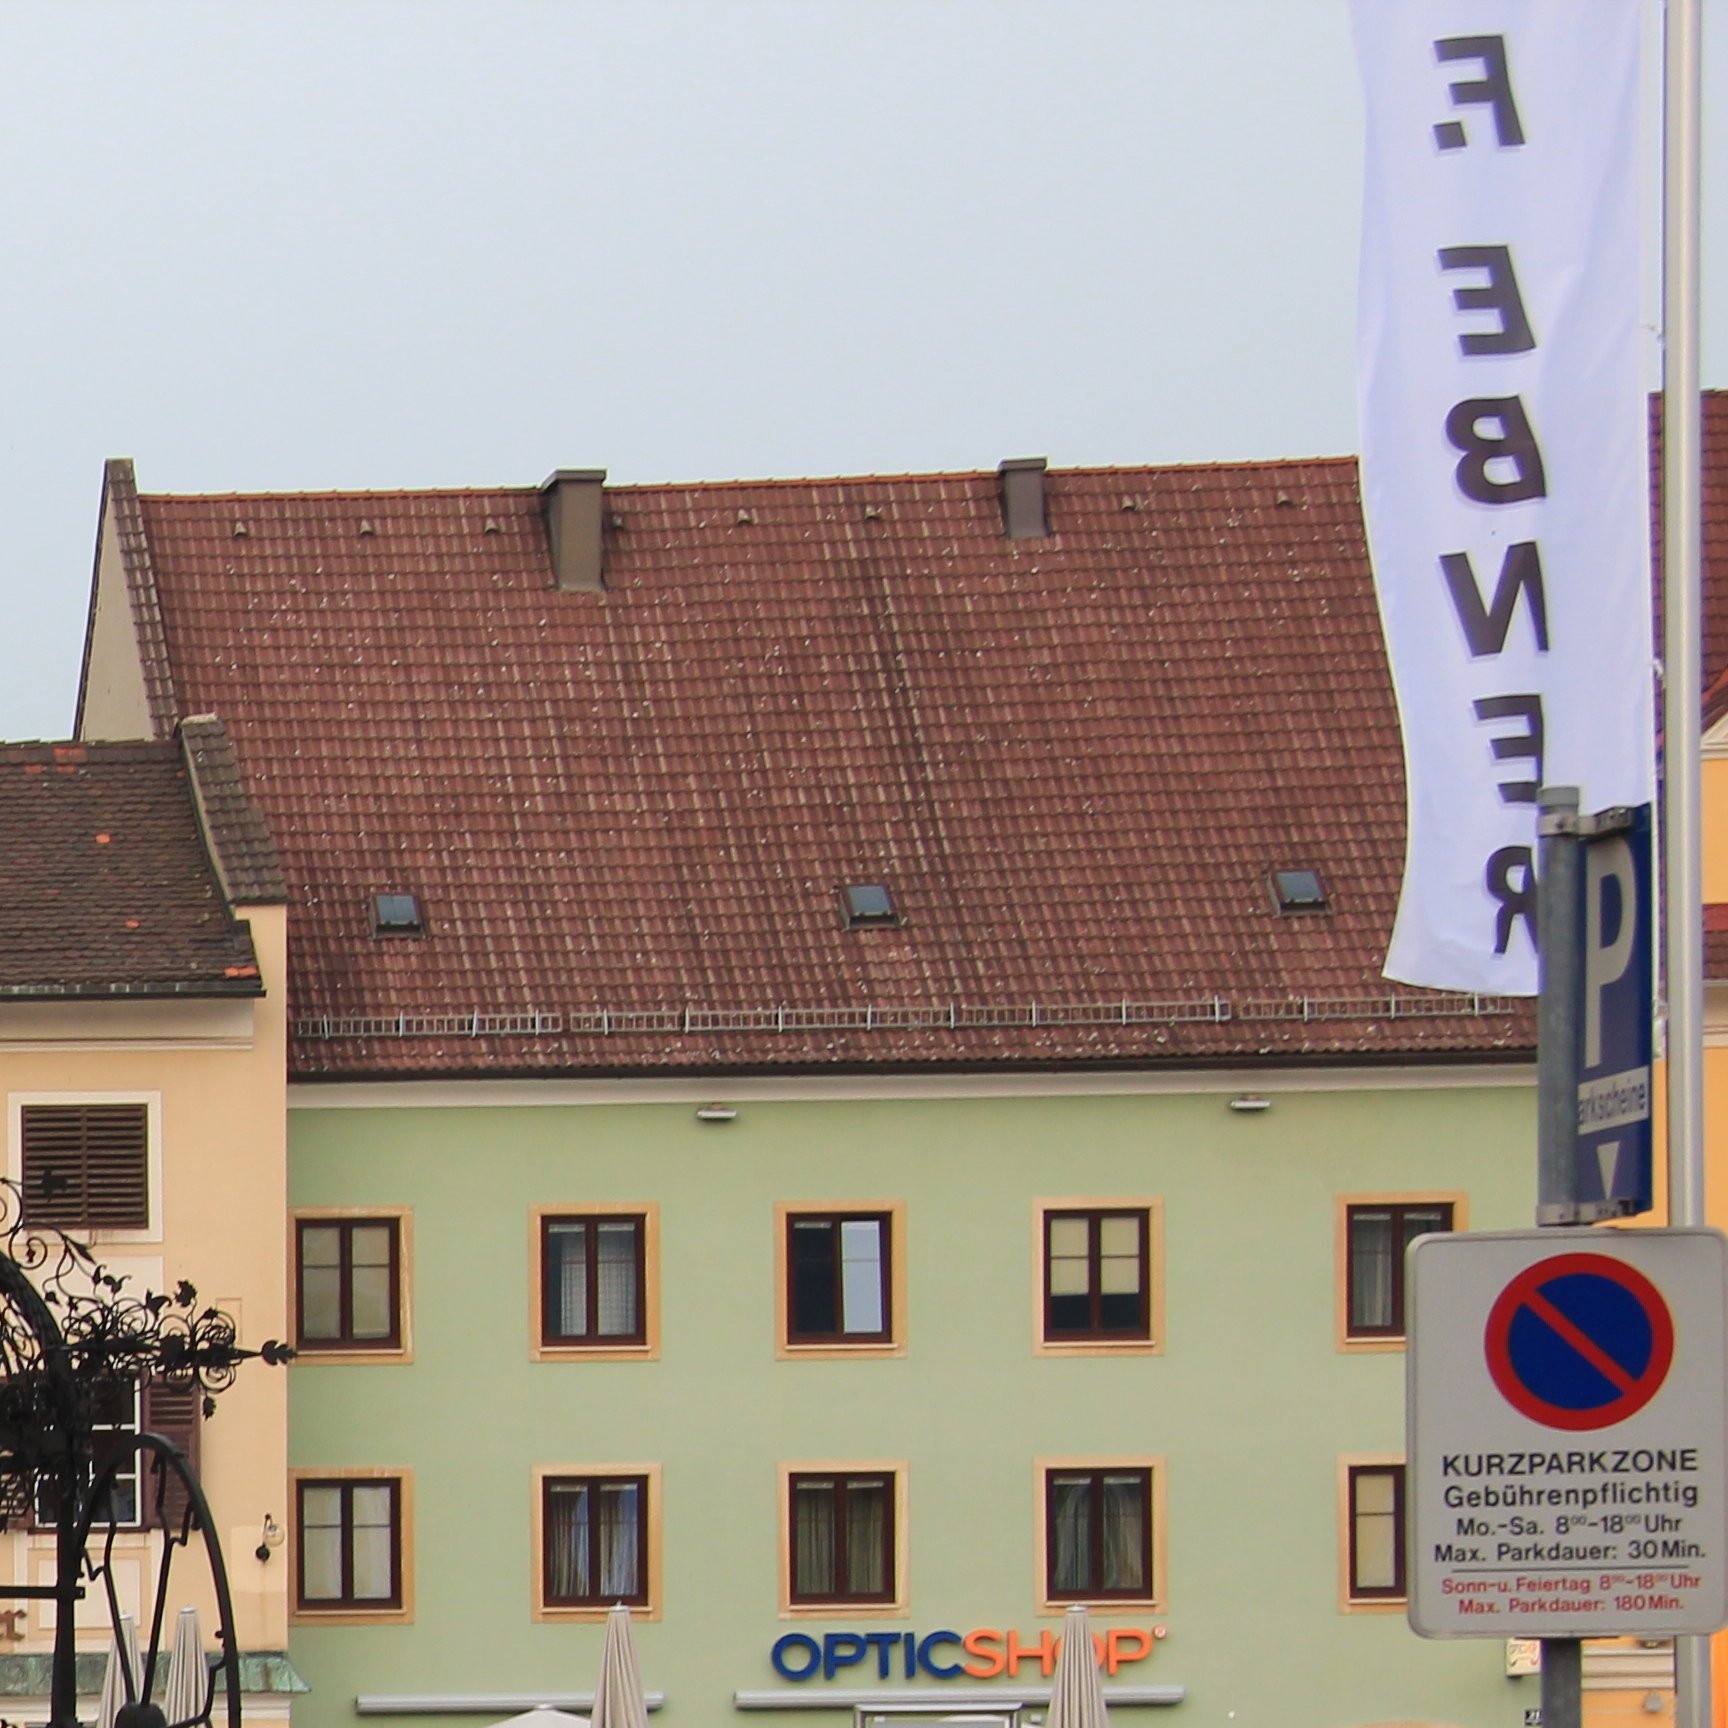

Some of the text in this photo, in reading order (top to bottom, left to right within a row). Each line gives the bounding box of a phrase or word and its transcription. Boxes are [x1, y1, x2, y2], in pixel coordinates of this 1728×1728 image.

[1584, 836, 1636, 1069] P
[1442, 1449, 1699, 1477] KURZPARKZONE
[1444, 1480, 1699, 1509] Gebührenpflichtig
[1456, 1516, 1545, 1537] Mo.-Sa.
[1645, 1515, 1682, 1533] Uhr
[1434, 1540, 1706, 1562] Max. Parkdauer: 30 Min.
[1516, 1575, 1591, 1594] Feiertag
[1670, 1573, 1702, 1589] Uhr
[1458, 1595, 1684, 1614] Max. Parkdauer: 180 Min.
